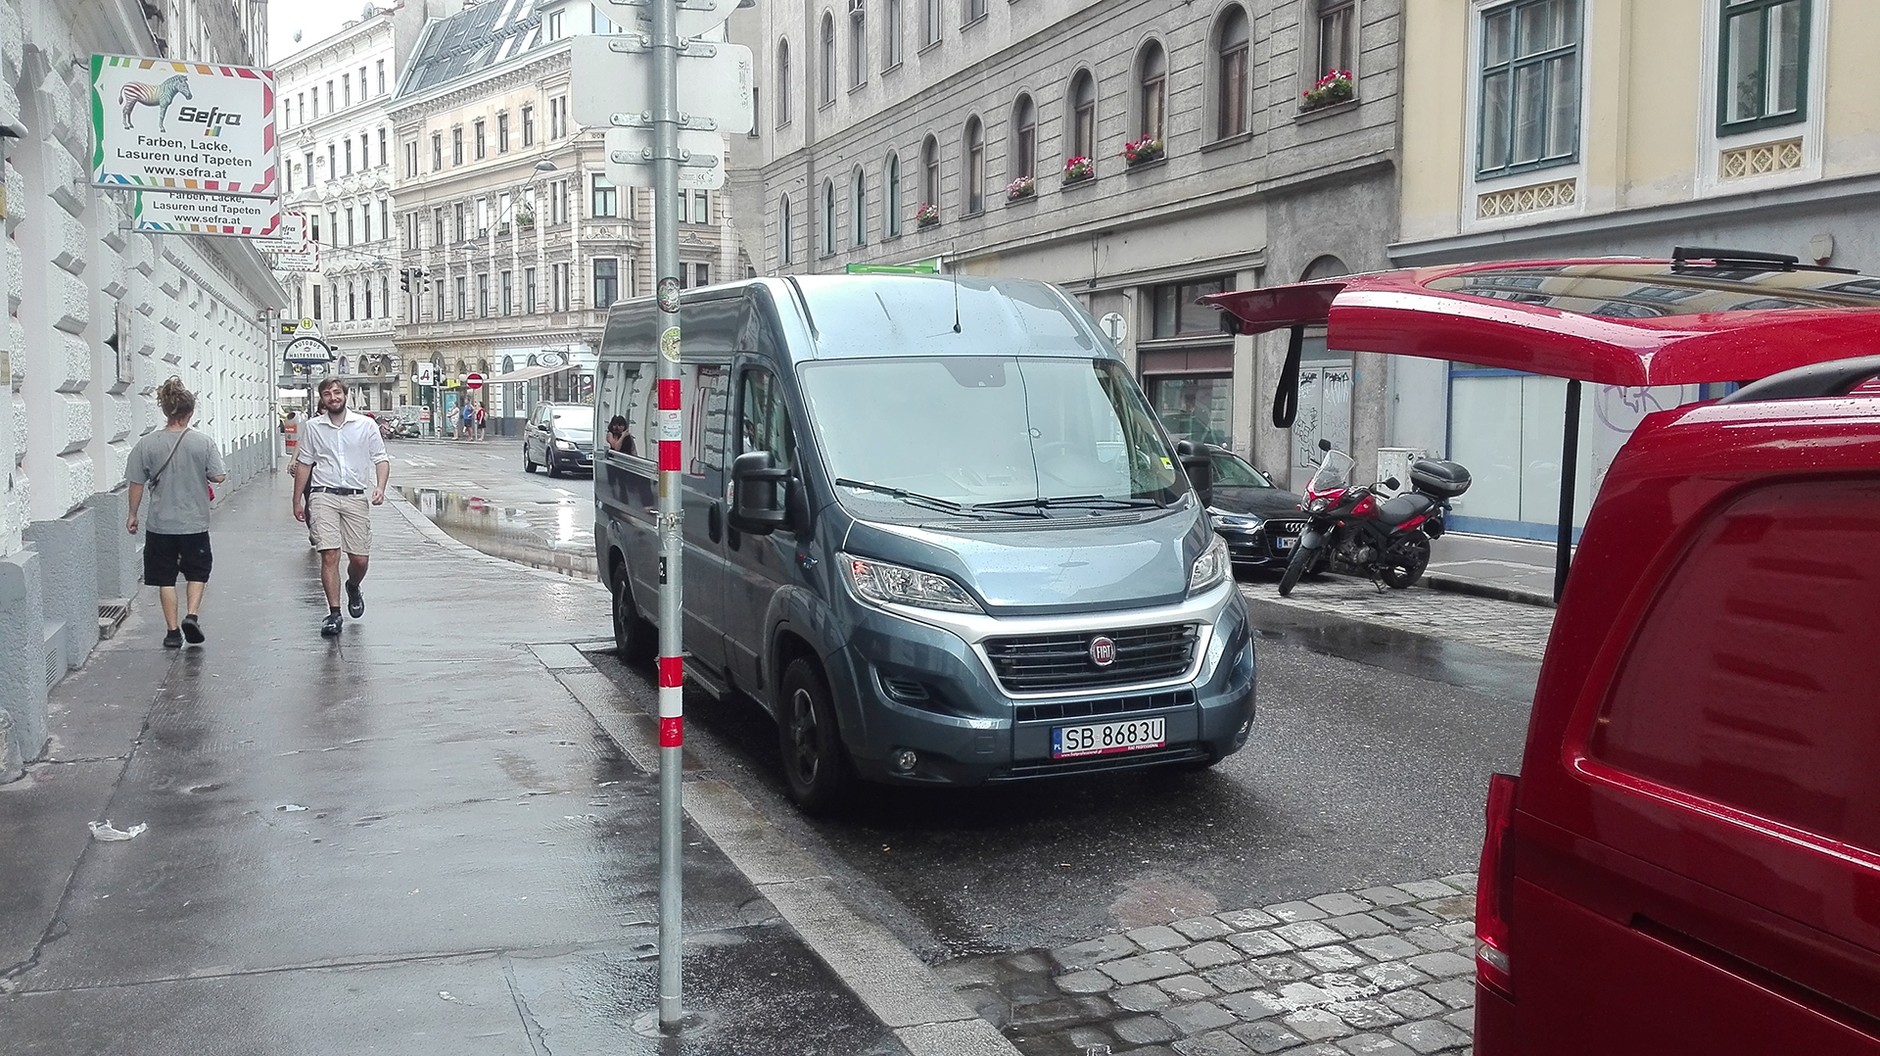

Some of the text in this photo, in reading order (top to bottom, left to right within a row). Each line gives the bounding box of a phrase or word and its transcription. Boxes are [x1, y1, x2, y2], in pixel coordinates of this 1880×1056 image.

[178, 107, 241, 127] Sefra
[138, 136, 232, 153] Farben, Lacke,
[117, 148, 252, 167] Lasuren und Tapeten
[144, 166, 227, 179] www.sefra.at
[153, 201, 261, 215] Lasuren und Tapeten
[174, 214, 241, 225] www.sefra.at
[294, 341, 321, 349] AUTOBUS
[1096, 645, 1111, 659] FIAT
[1066, 720, 1163, 750] SB 8683U
